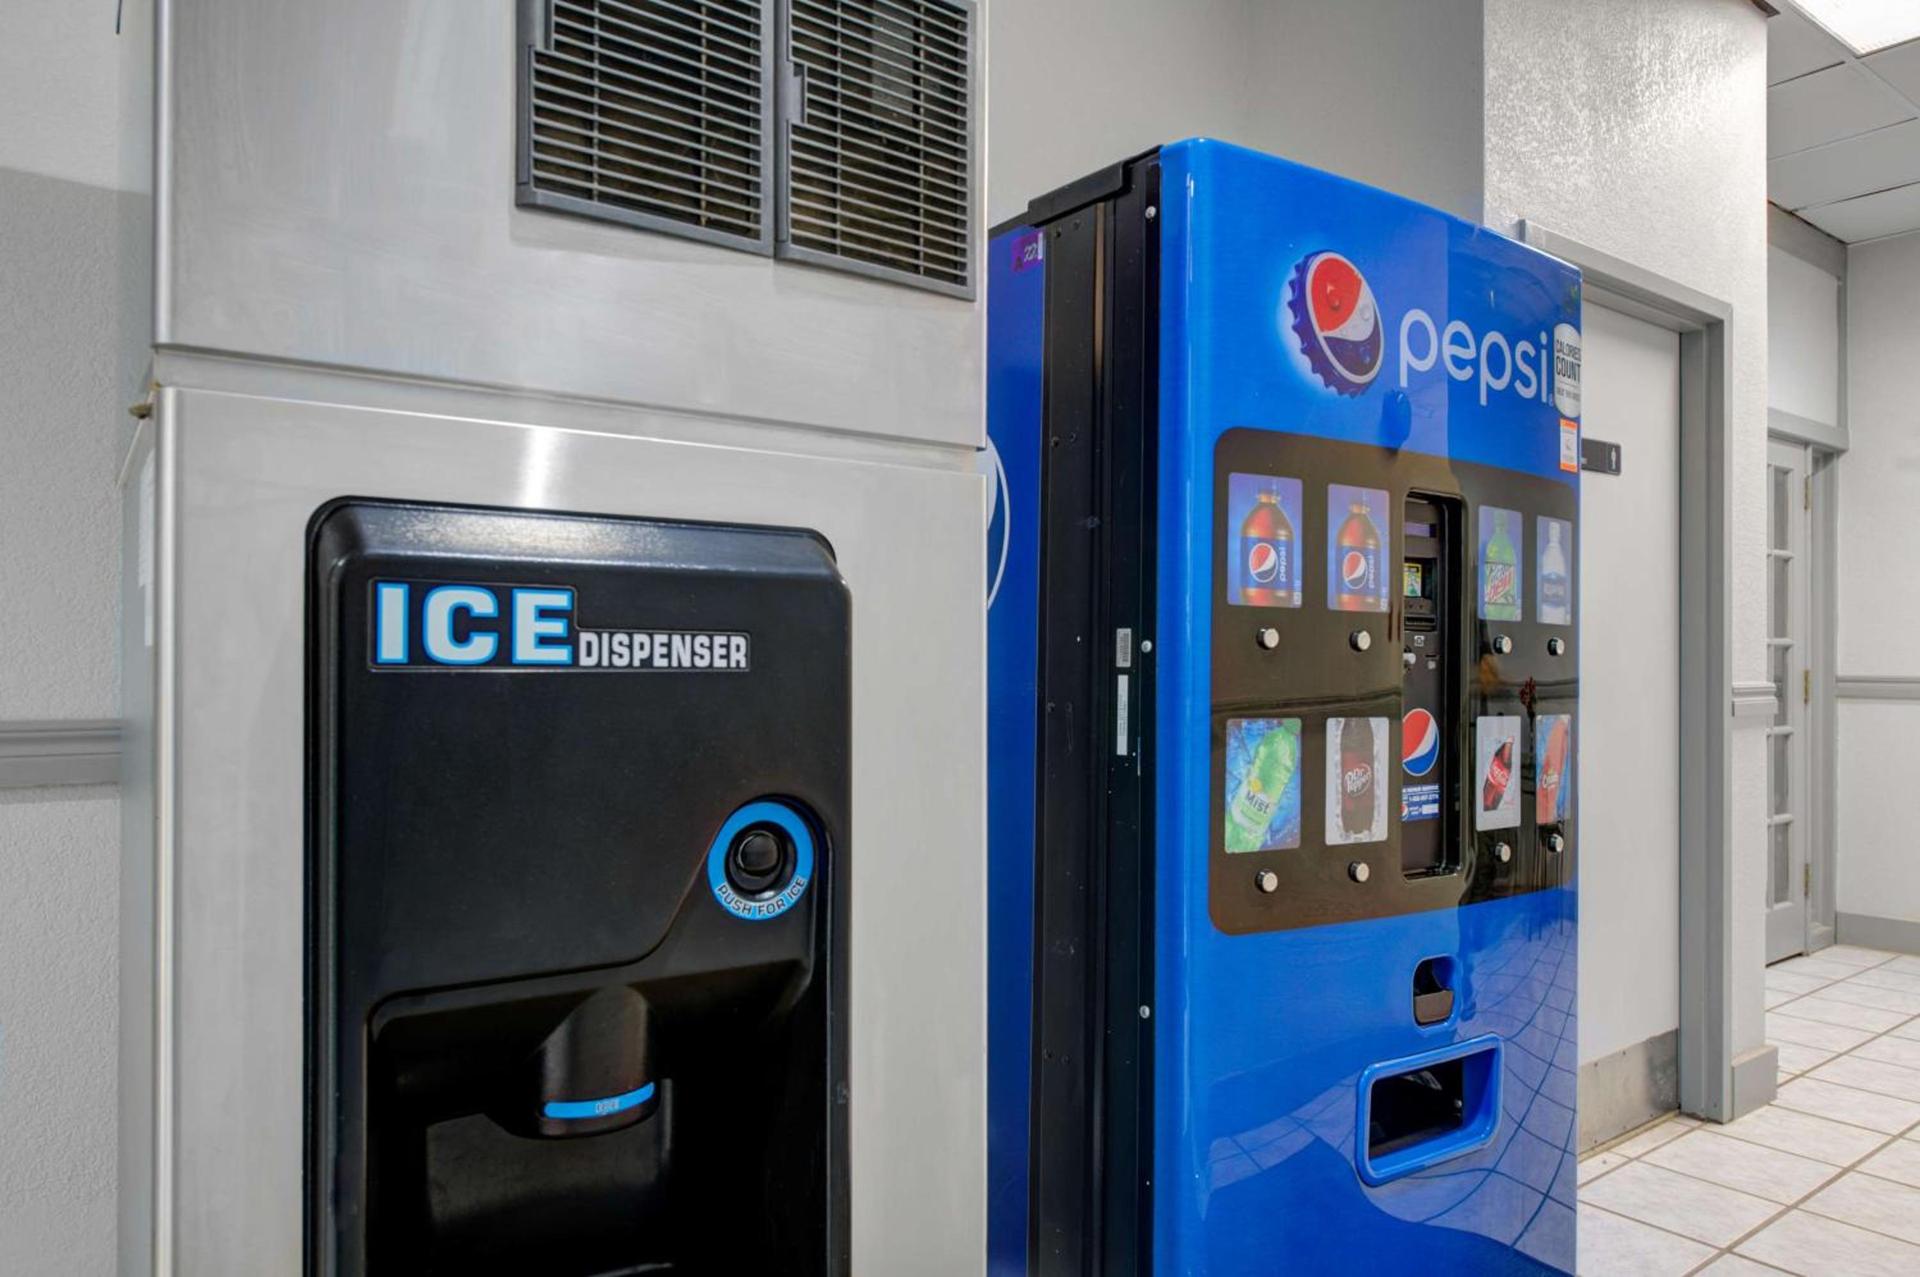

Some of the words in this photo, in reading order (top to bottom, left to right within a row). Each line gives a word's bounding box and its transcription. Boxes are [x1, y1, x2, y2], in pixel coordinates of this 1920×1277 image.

[1400, 308, 1548, 406] pepsi
[1556, 356, 1581, 384] COUNT
[376, 582, 574, 666] ICE
[579, 631, 748, 669] DISPENSER
[717, 884, 752, 915] PUSH
[757, 899, 786, 916] FOR
[787, 877, 805, 900] ICE
